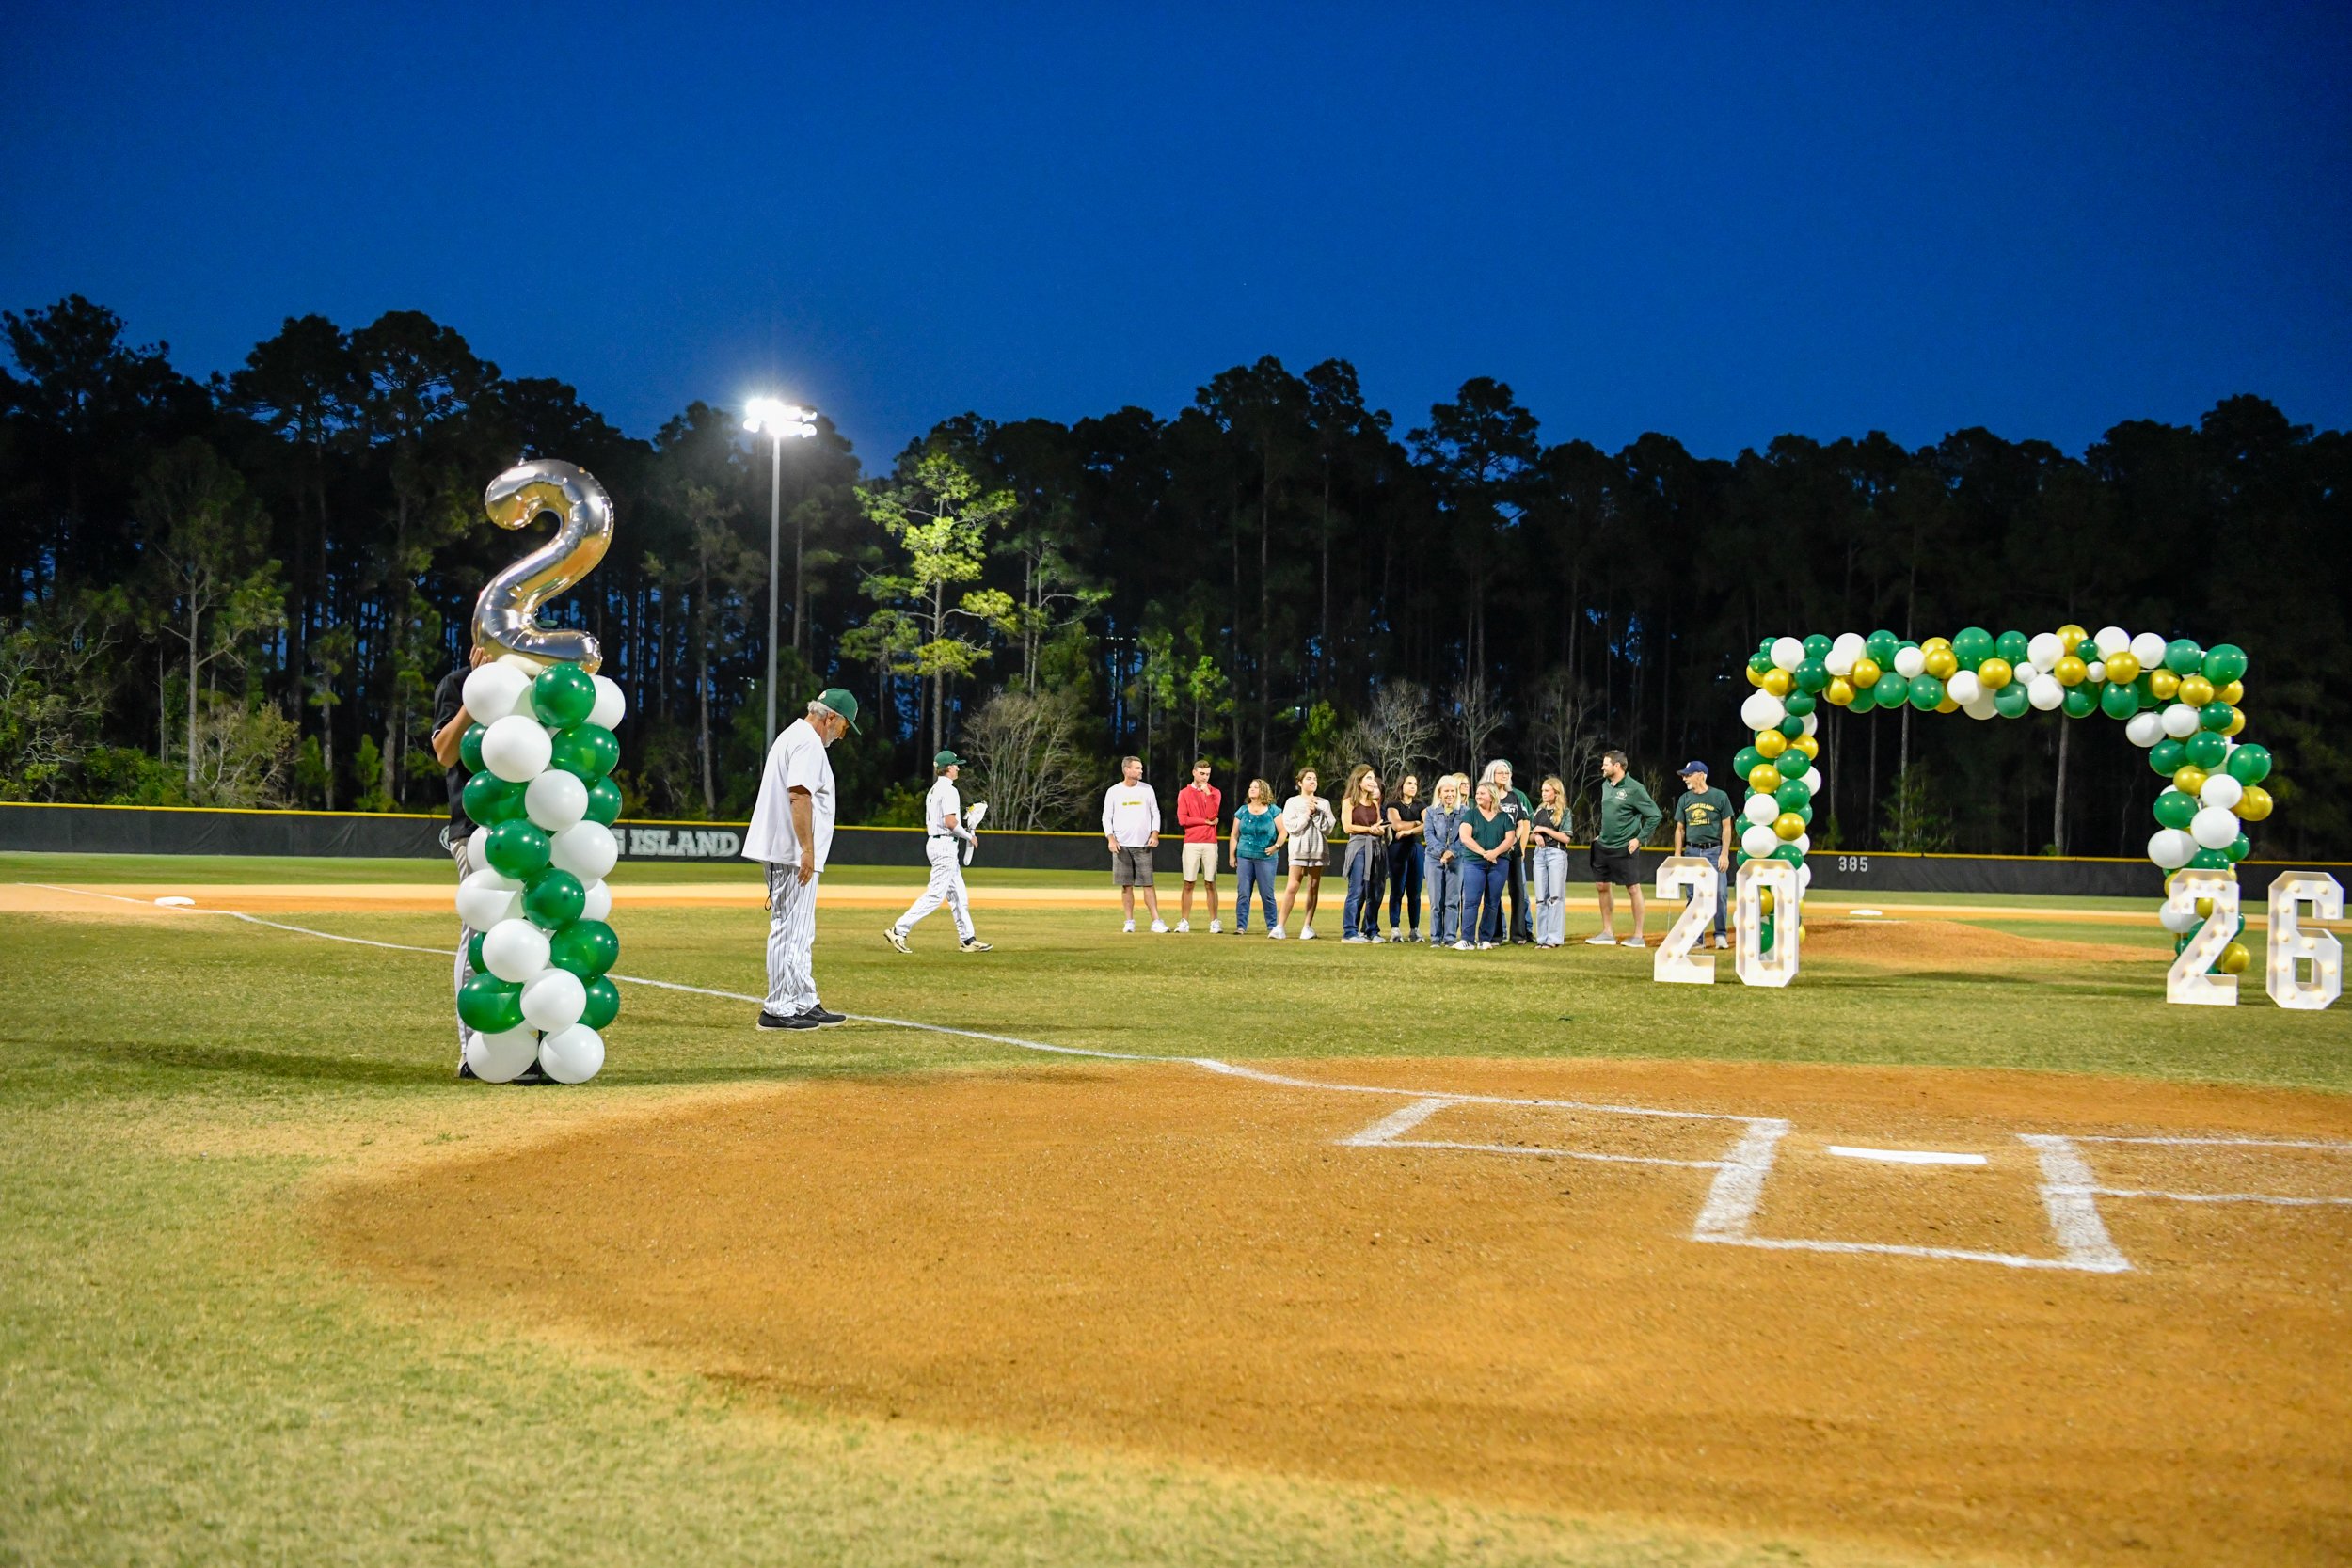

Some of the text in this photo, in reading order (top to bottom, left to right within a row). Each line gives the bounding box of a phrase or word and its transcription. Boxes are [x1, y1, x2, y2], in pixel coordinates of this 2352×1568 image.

[471, 458, 615, 673] 2
[629, 829, 740, 857] ISLAND
[1838, 855, 1868, 873] 385
